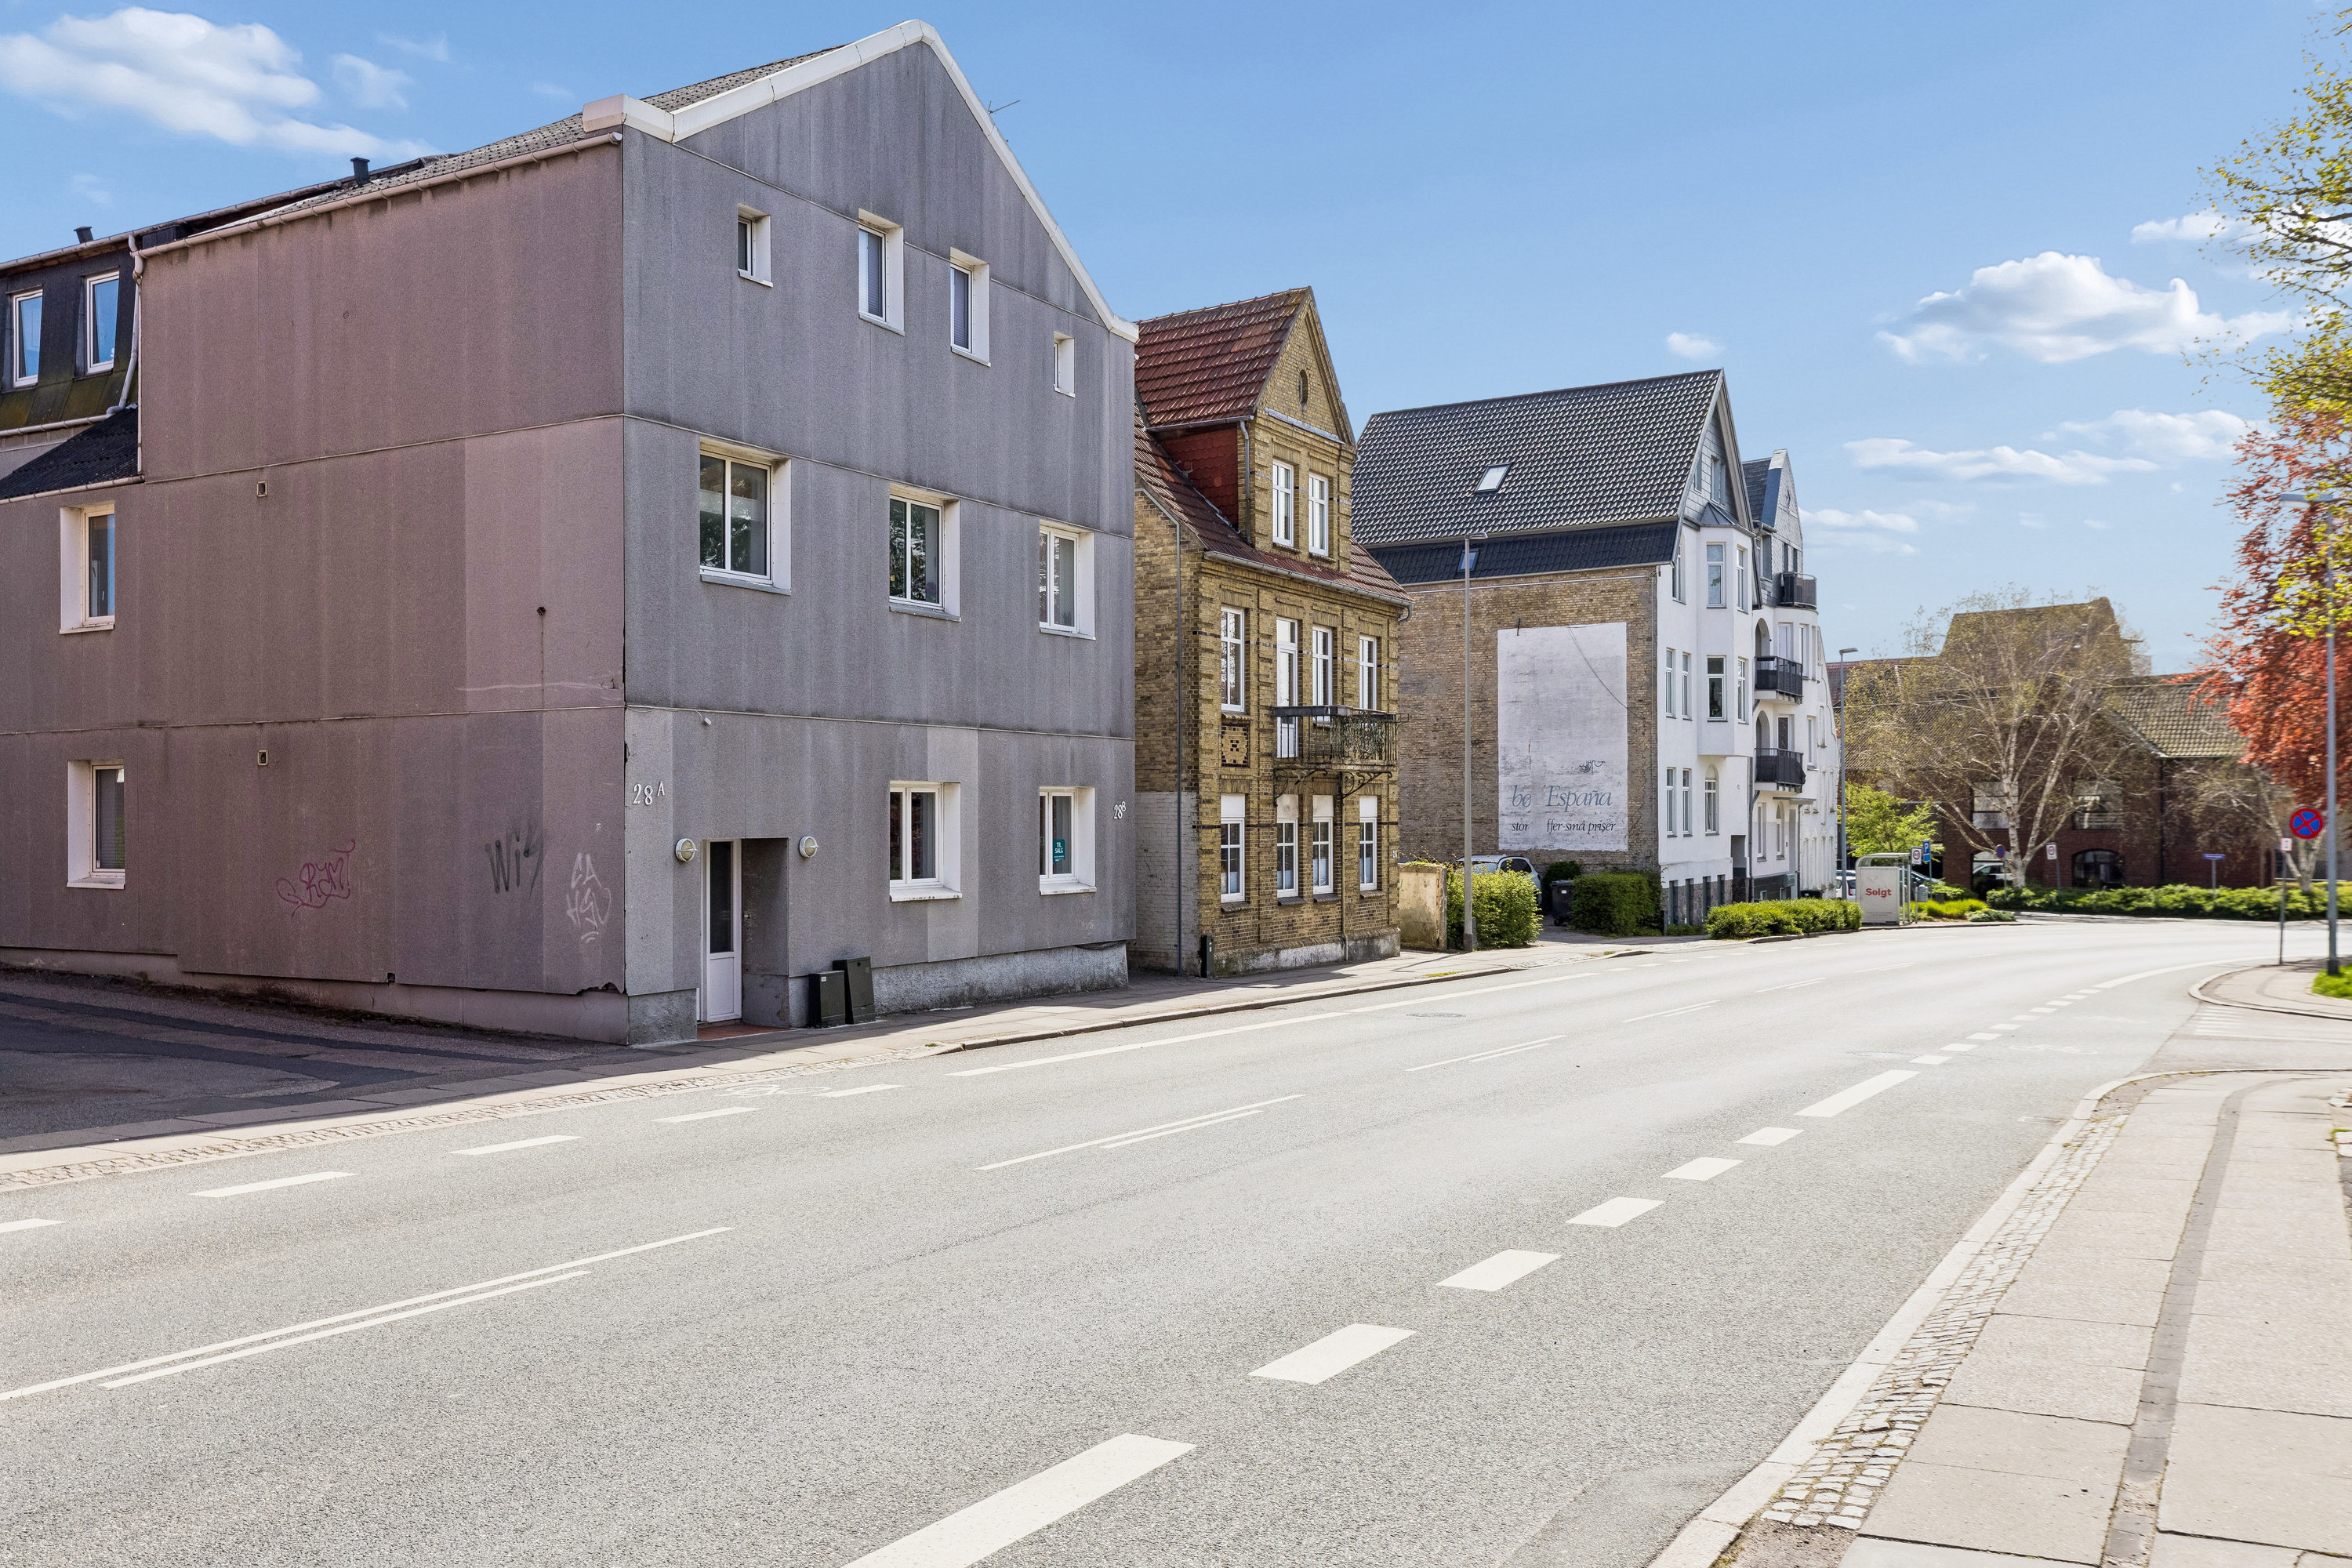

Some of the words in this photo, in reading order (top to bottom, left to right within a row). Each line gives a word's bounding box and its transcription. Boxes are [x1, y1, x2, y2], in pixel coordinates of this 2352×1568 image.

[1545, 786, 1613, 812] España
[1587, 820, 1616, 835] priser
[1865, 887, 1892, 898] Solgt
